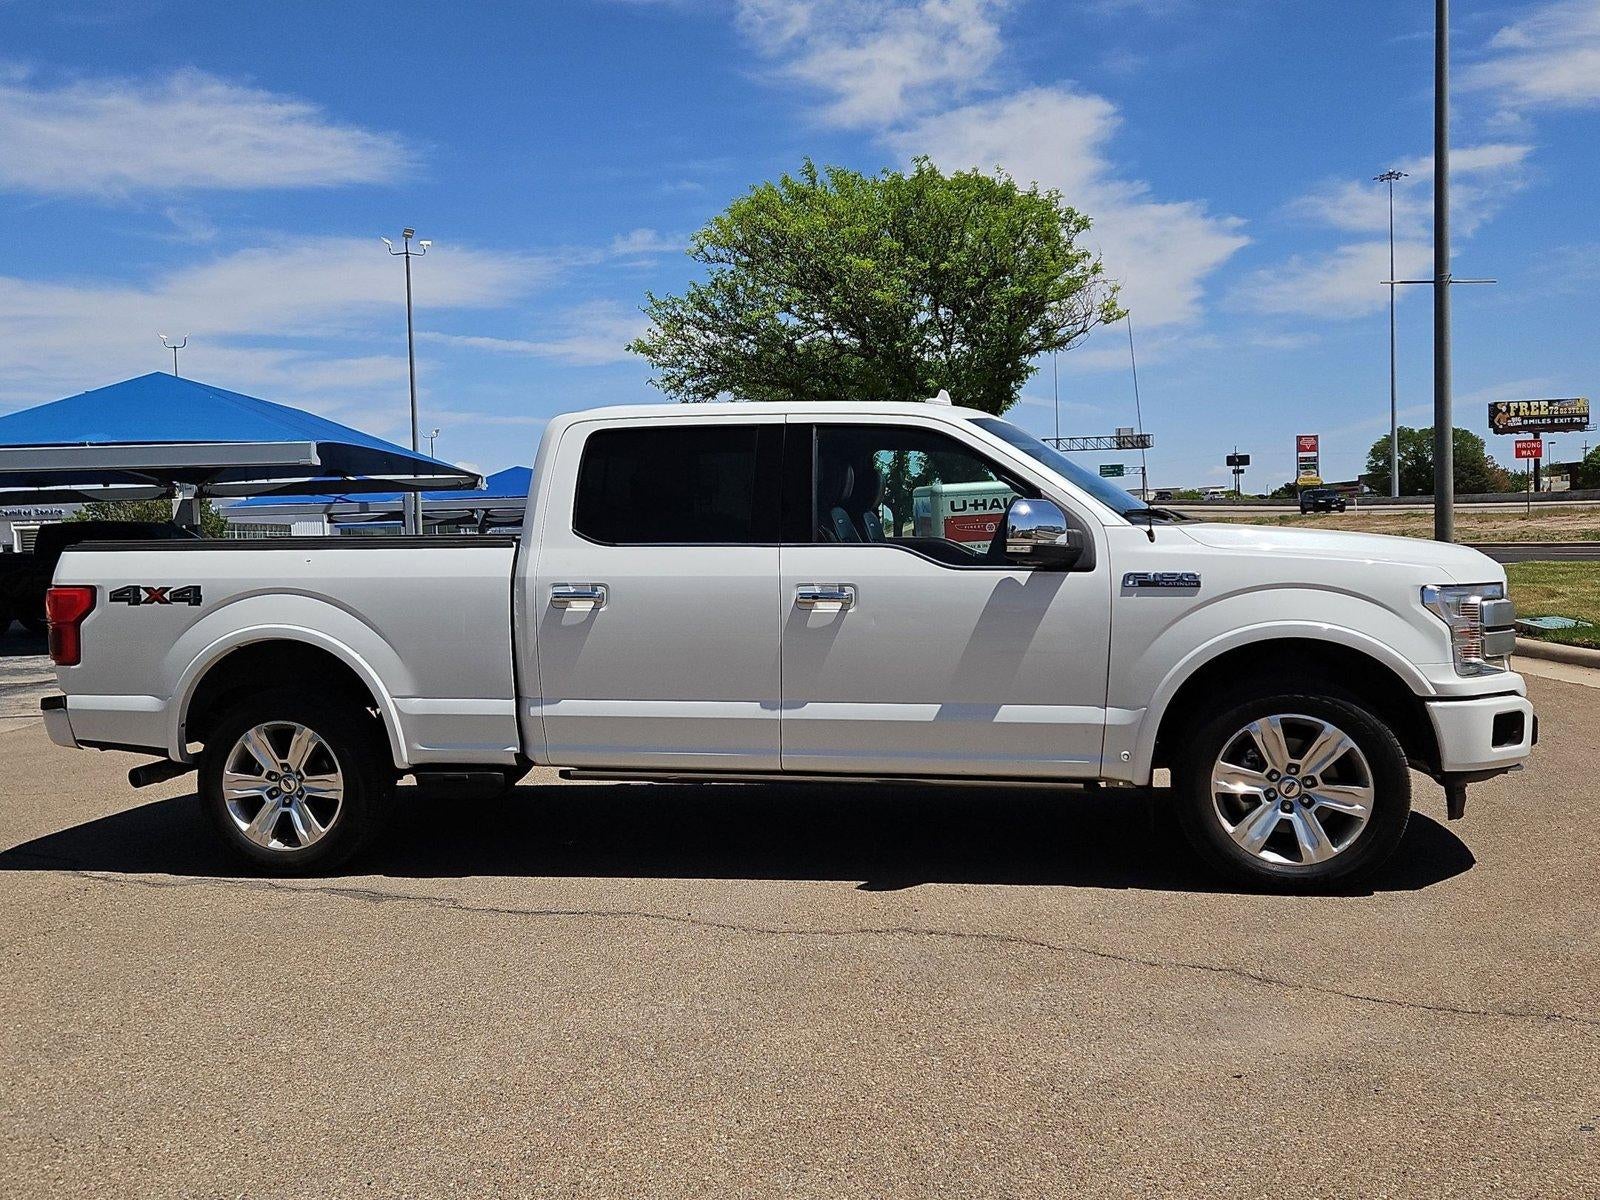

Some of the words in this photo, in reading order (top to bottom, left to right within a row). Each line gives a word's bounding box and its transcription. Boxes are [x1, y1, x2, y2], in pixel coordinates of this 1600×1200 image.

[1509, 401, 1549, 416] FREE
[1549, 406, 1559, 415] 72
[1516, 441, 1541, 449] WRONG
